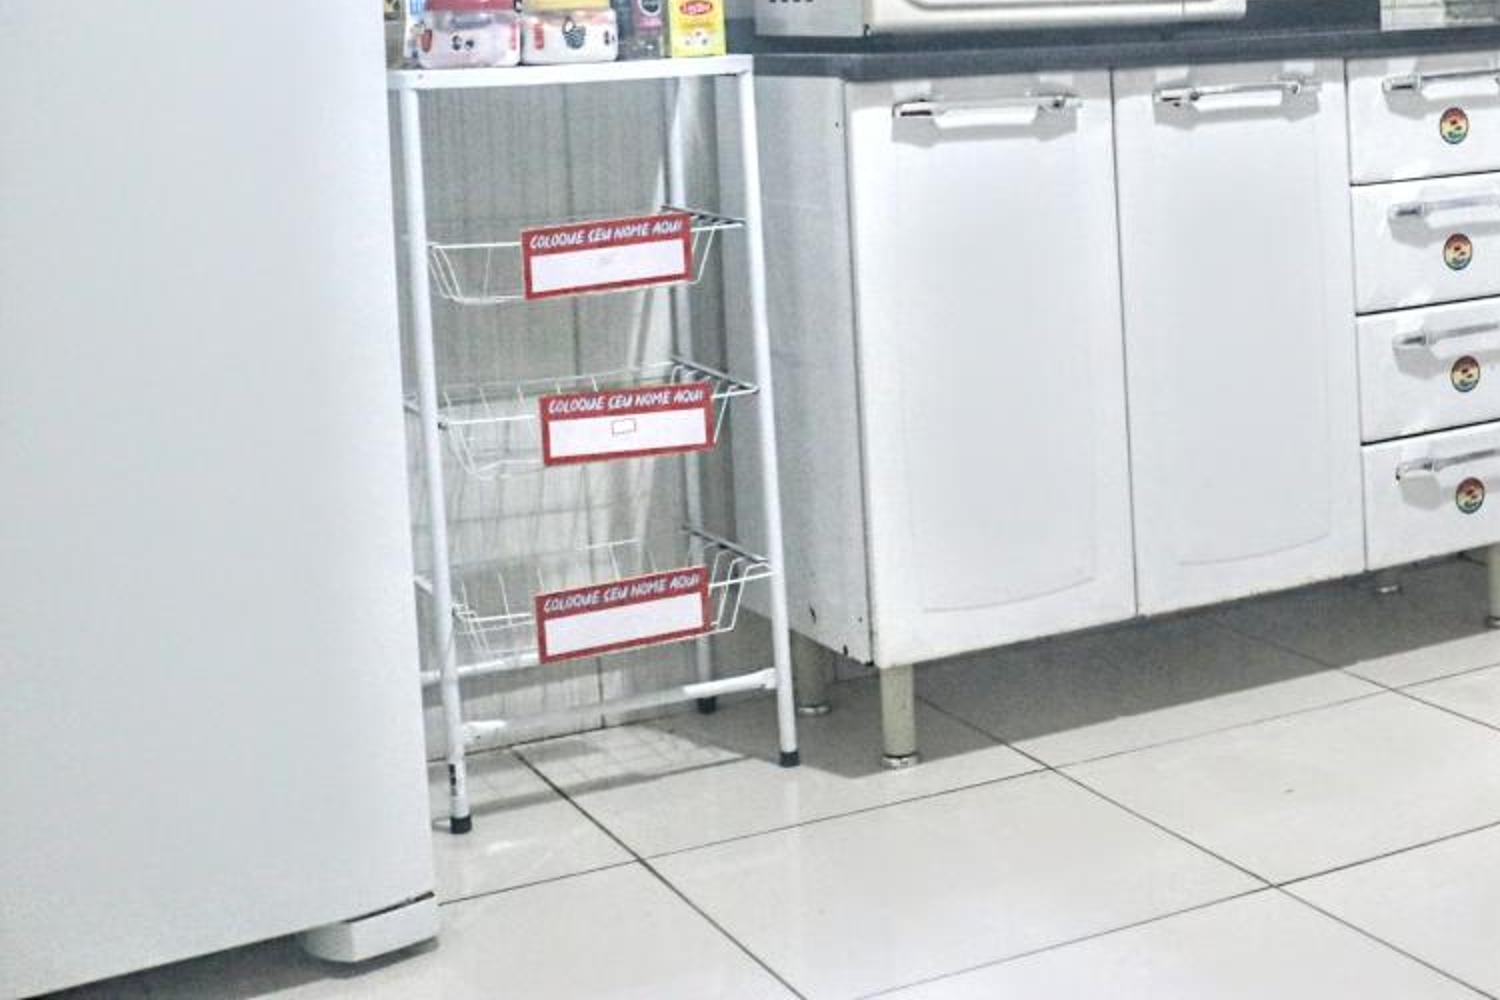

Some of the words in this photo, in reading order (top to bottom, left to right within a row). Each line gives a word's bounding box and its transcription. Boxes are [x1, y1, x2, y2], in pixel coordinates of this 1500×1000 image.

[530, 230, 584, 250] COLOQUE
[614, 223, 649, 240] NOME
[548, 395, 604, 414] COLOQUE
[634, 391, 671, 408] NOME
[543, 592, 600, 613] COLOQUE
[630, 579, 667, 597] NOME
